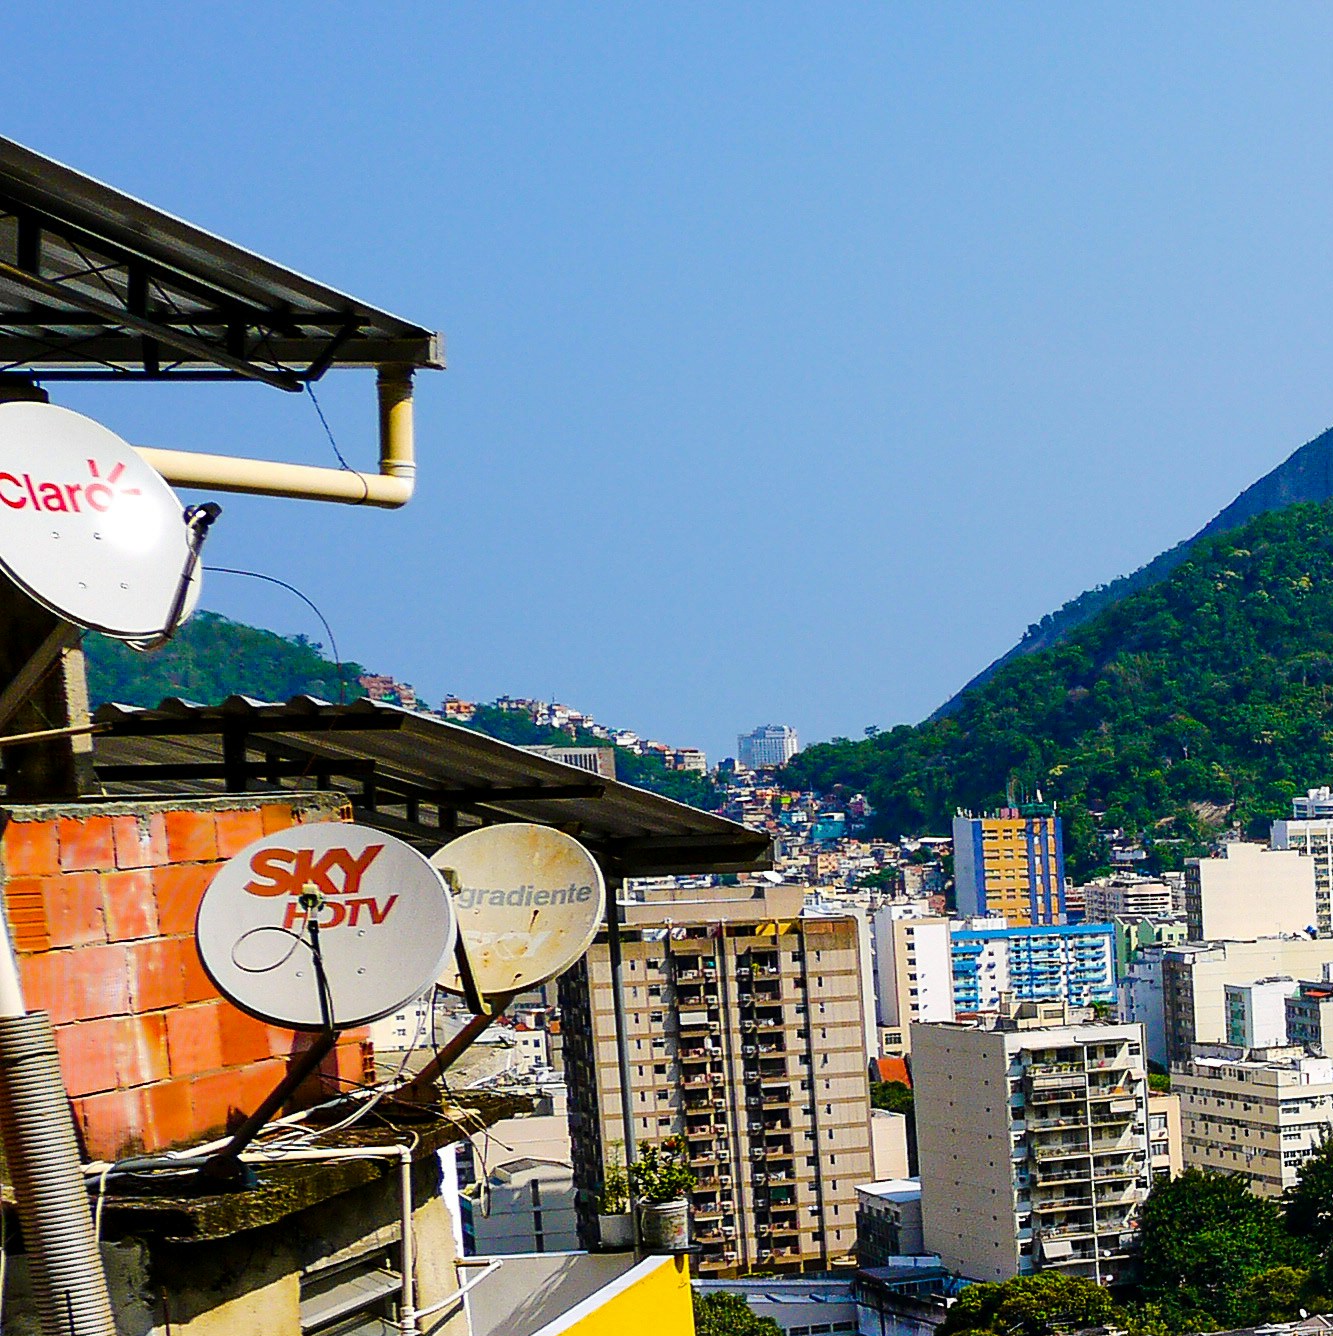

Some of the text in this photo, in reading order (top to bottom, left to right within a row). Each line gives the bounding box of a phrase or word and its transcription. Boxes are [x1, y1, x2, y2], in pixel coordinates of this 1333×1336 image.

[0, 468, 118, 513] Claro
[243, 844, 384, 897] SKY
[282, 895, 399, 929] HDTV
[457, 882, 592, 908] gradiente
